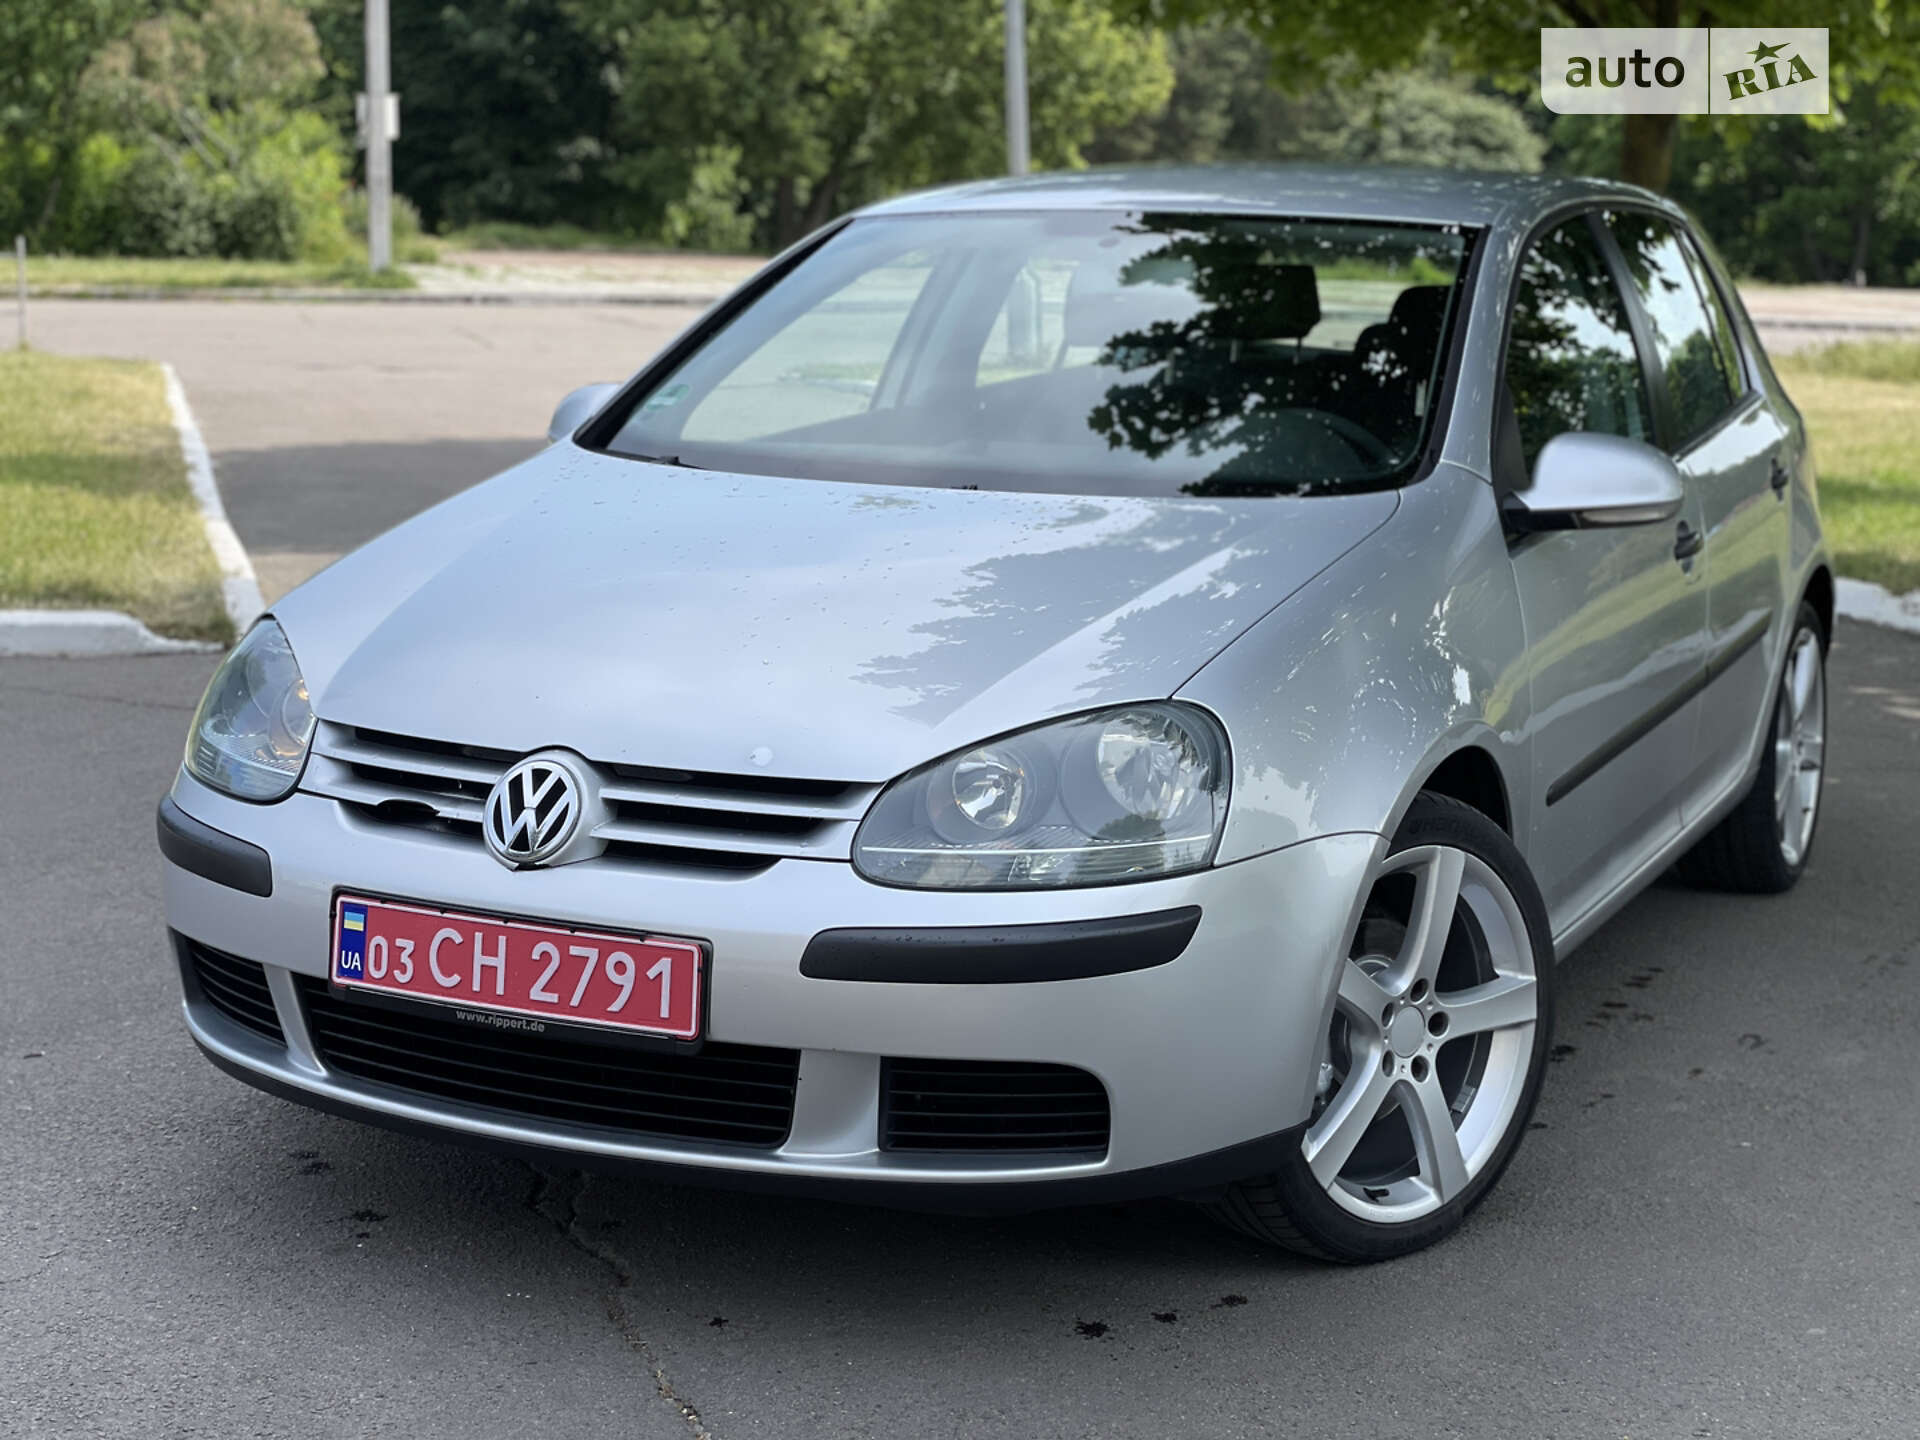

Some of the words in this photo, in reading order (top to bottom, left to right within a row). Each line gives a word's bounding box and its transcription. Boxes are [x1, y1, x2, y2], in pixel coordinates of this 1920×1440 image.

[341, 949, 362, 972] UA
[367, 935, 415, 984] 03
[428, 927, 507, 996] CH
[528, 941, 673, 1019] 2791
[455, 1008, 545, 1034] www.rippert.de
